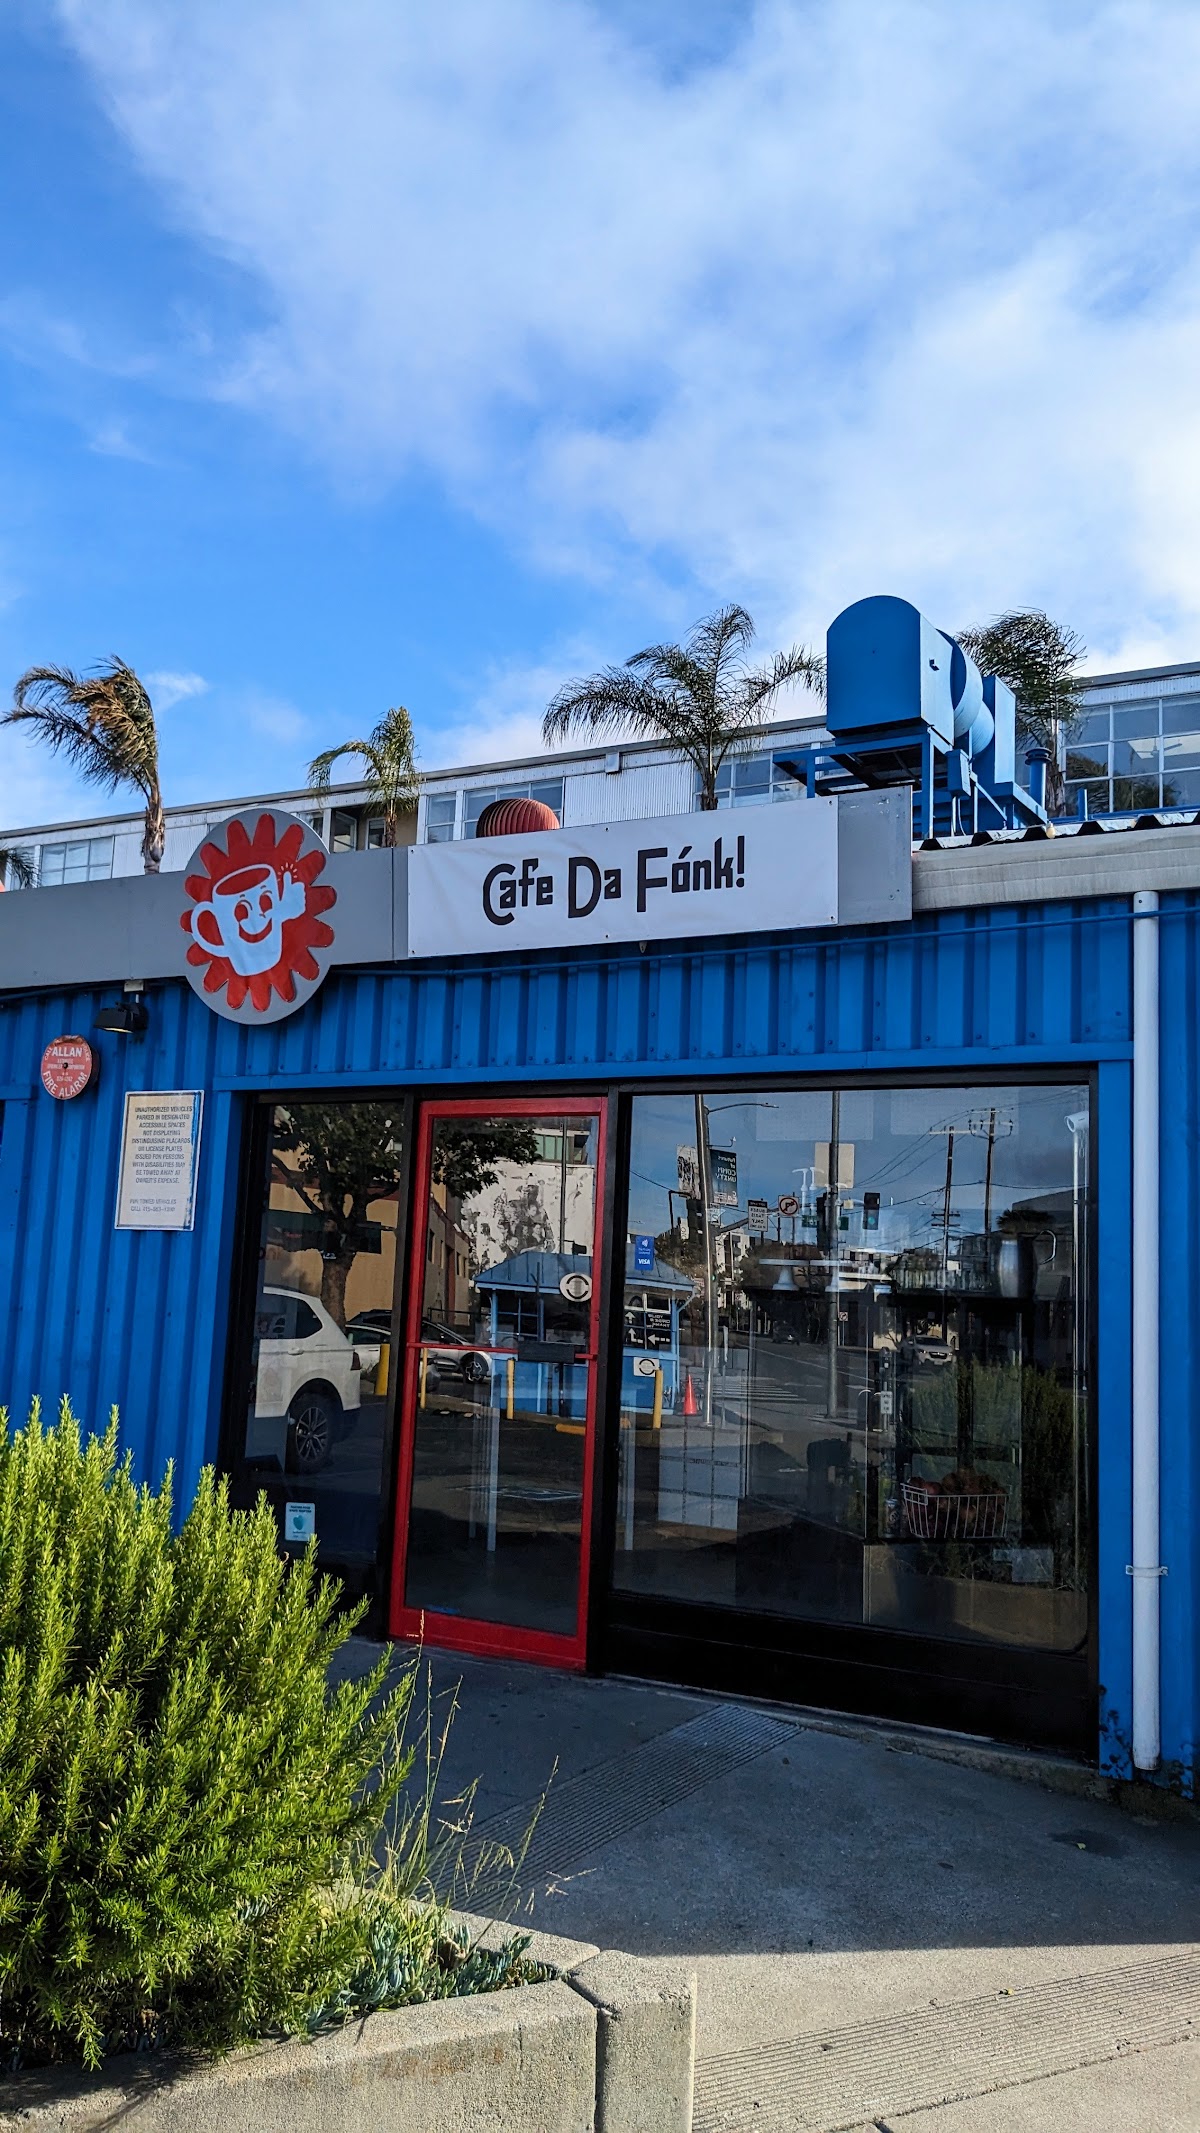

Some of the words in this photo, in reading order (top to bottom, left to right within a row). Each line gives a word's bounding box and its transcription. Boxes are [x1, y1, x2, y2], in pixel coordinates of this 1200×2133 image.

[483, 858, 553, 925] Cafe
[568, 856, 621, 918] Da
[637, 836, 745, 912] Fónk!
[52, 1046, 83, 1057] ALLAN
[43, 1070, 58, 1094] FIRE
[58, 1072, 88, 1098] ALARM
